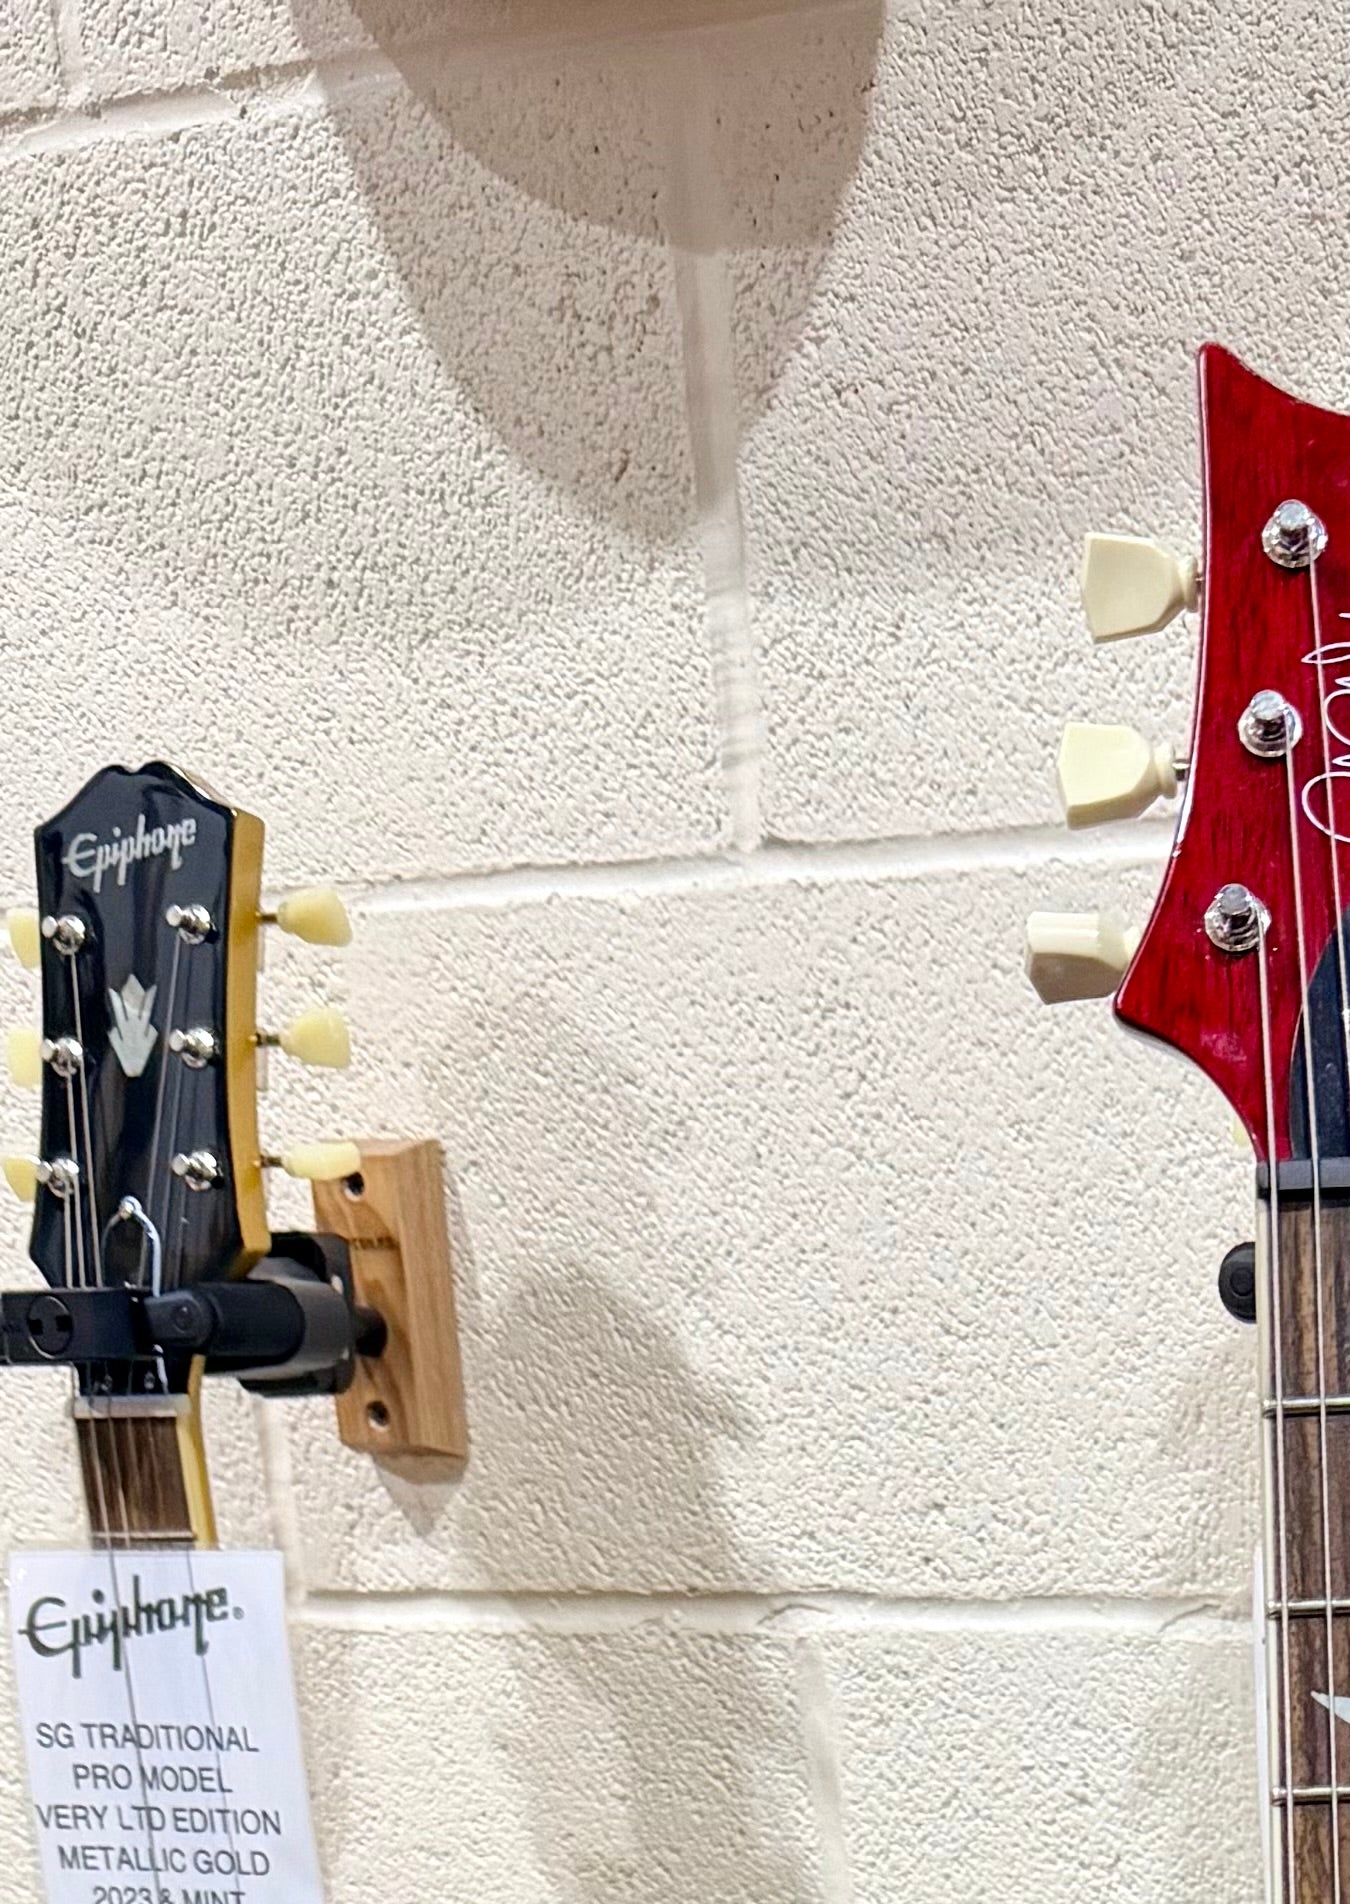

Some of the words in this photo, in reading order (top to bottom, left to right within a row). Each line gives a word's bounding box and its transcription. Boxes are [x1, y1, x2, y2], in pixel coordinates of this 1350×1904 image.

[61, 813, 197, 893] Epiphone
[36, 1723, 75, 1750] SG
[81, 1723, 259, 1753] TRADITIONAL
[74, 1765, 132, 1790] PRO
[140, 1766, 233, 1794] MODEL
[37, 1805, 107, 1832] VERY
[117, 1806, 166, 1832] LTD
[173, 1809, 282, 1836] EDITION
[58, 1846, 186, 1873] METALLIC
[194, 1850, 270, 1876] GOLD
